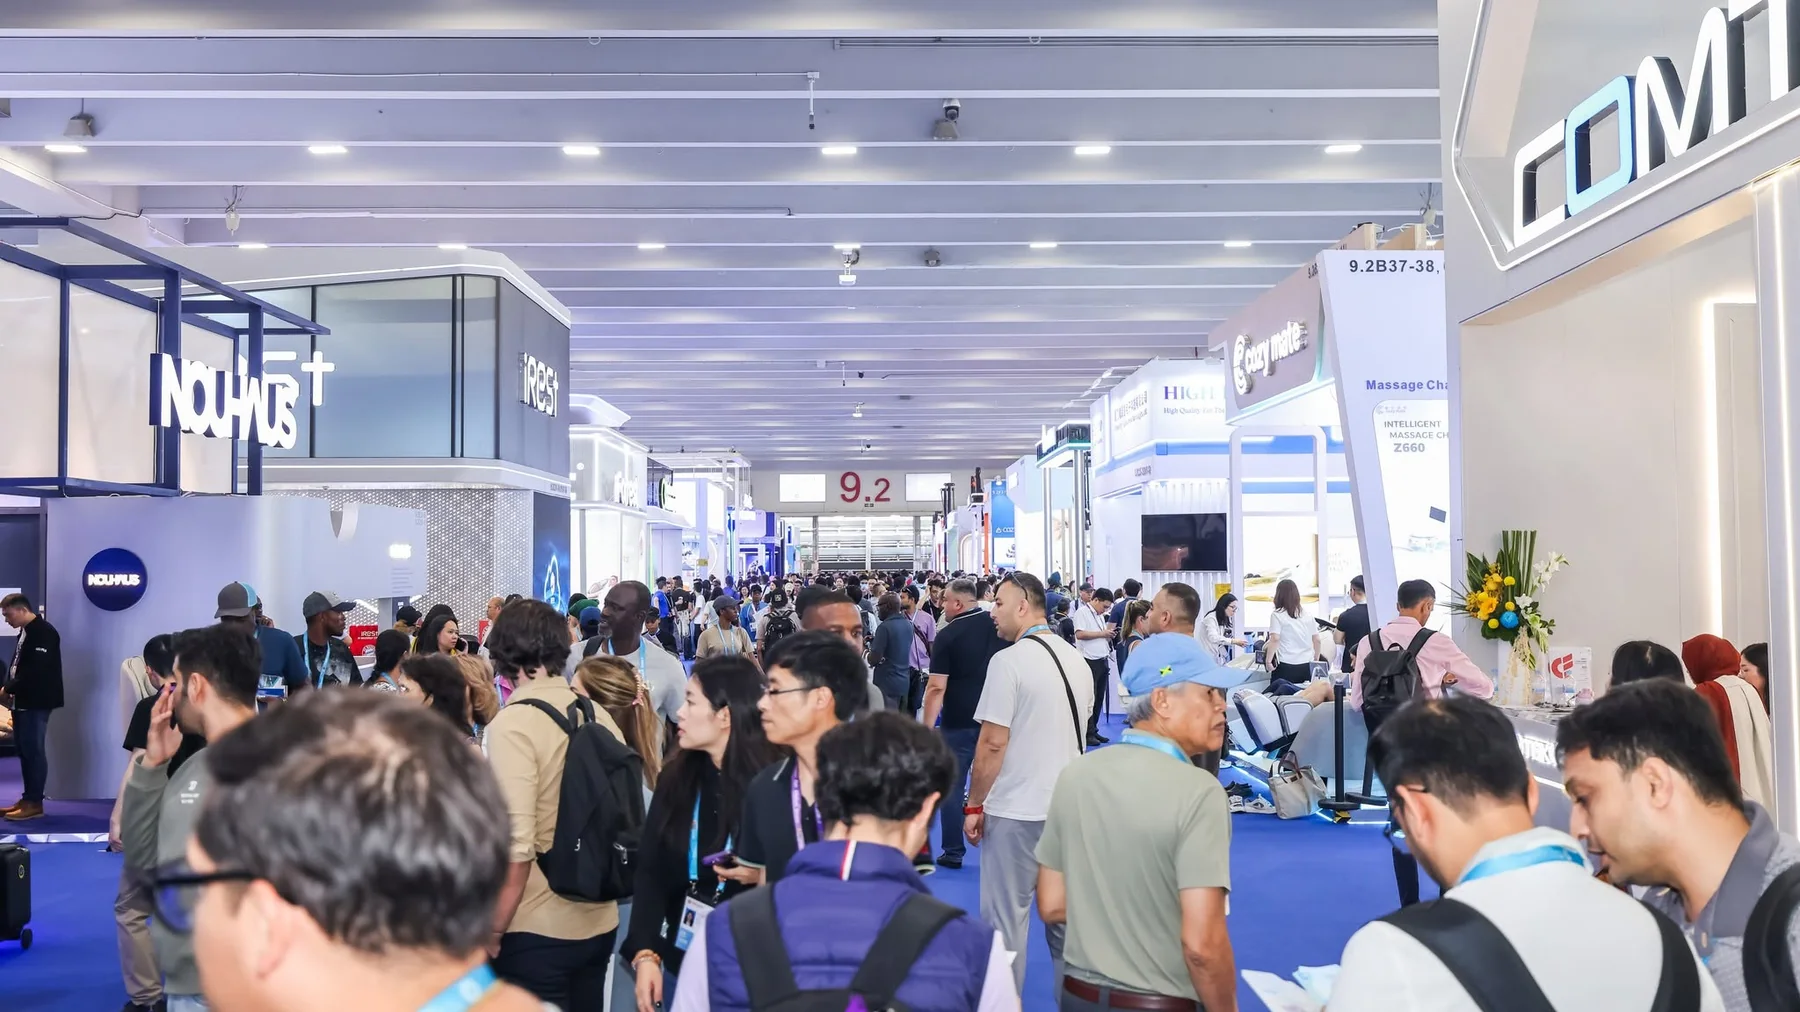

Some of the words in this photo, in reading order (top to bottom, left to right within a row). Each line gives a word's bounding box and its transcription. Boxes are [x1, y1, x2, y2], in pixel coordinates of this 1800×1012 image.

[1349, 259, 1445, 275] 9.2B37-38,
[1366, 380, 1424, 392] Massage
[1384, 420, 1442, 428] INTELLIGENT
[1389, 431, 1434, 439] MASSAGE
[1393, 442, 1426, 453] Z660
[840, 471, 891, 503] 9.2
[88, 574, 140, 586] NOUHAUS
